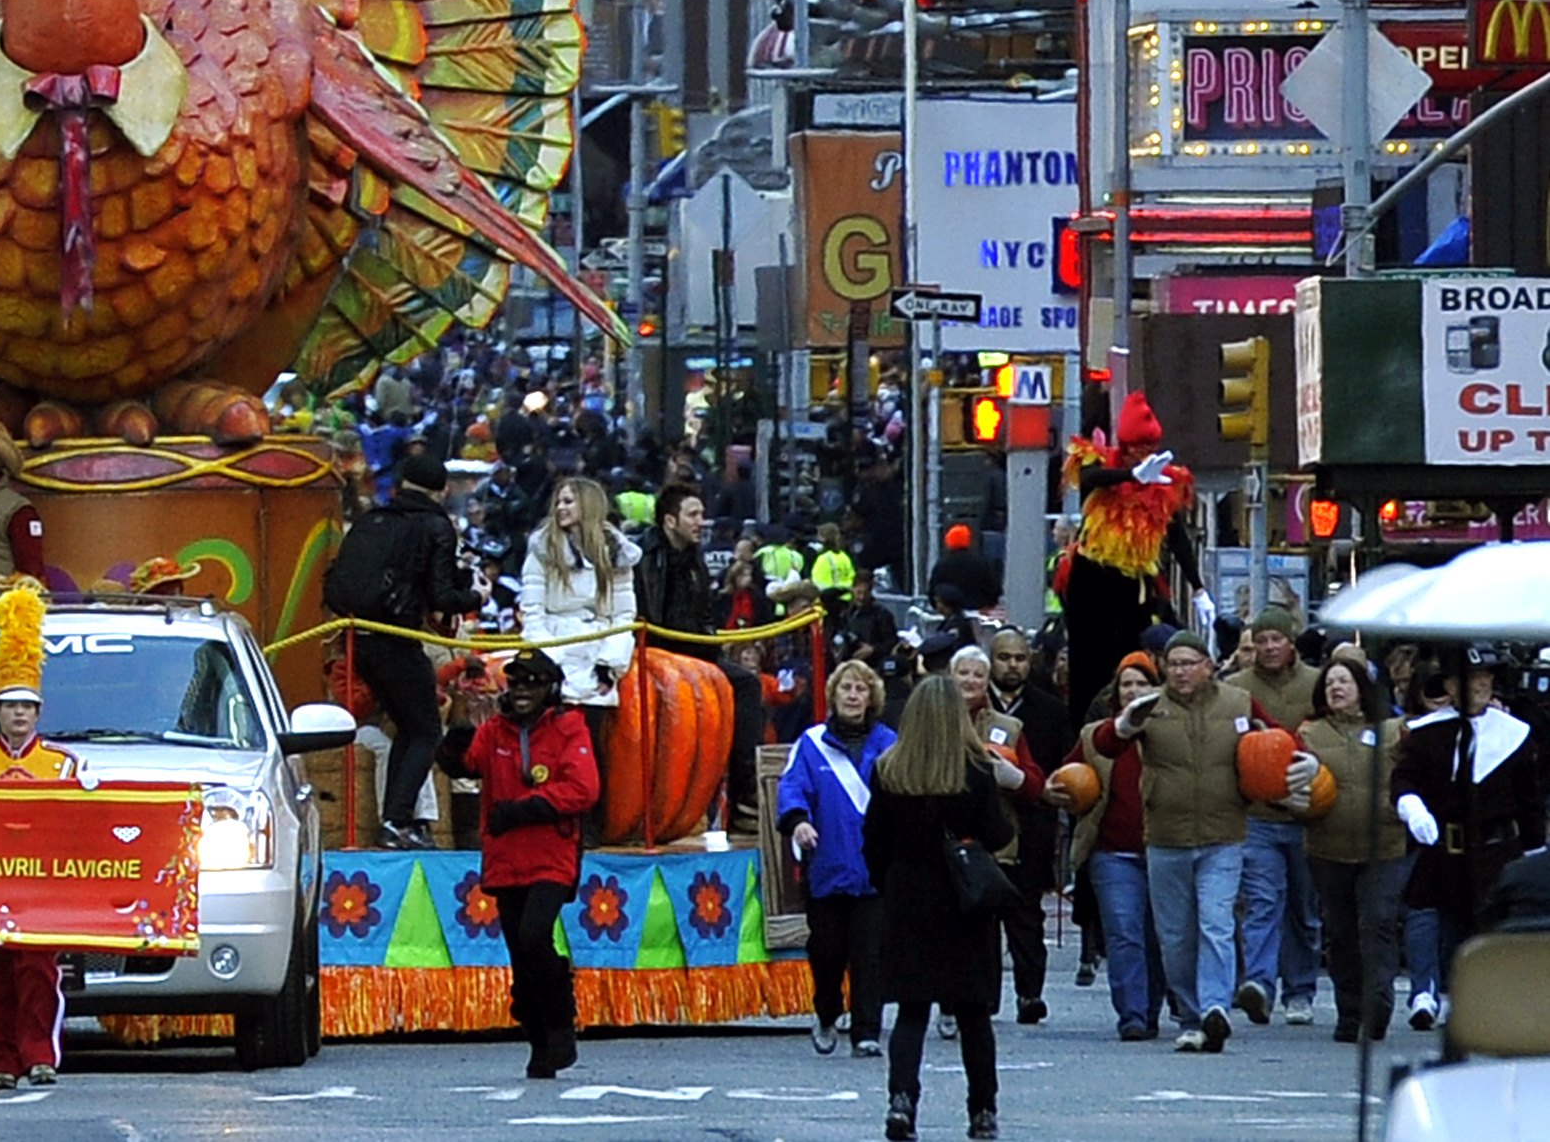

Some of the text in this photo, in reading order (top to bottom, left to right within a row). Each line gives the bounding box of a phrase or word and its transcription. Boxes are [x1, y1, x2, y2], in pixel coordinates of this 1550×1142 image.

[980, 239, 1047, 269] NYC
[1458, 383, 1550, 417] CL
[1458, 429, 1515, 453] UP
[53, 859, 142, 879] LAVIGNE
